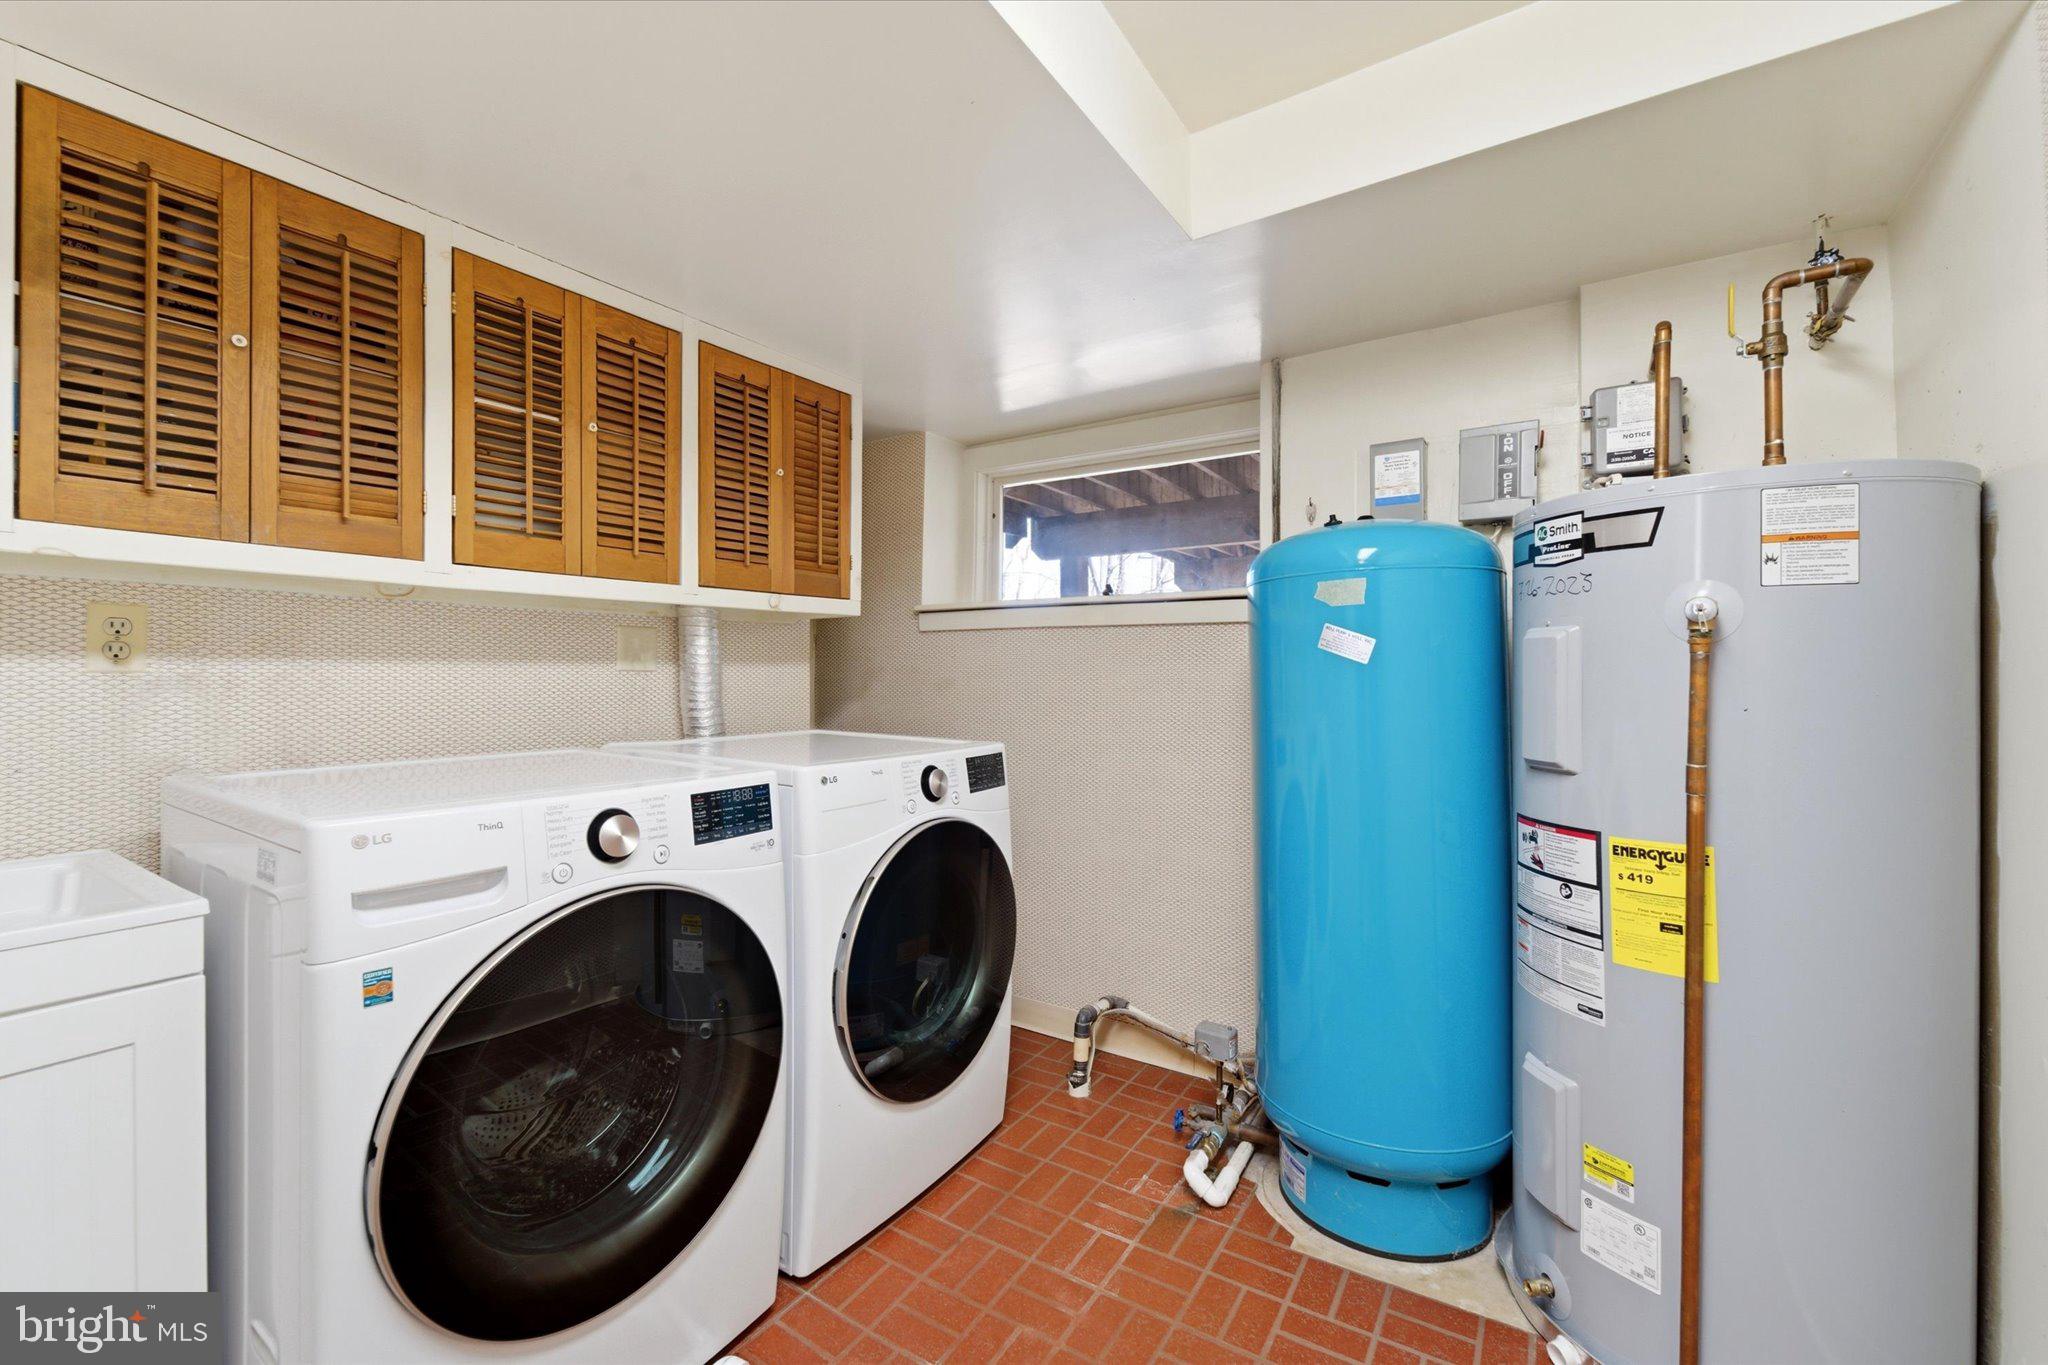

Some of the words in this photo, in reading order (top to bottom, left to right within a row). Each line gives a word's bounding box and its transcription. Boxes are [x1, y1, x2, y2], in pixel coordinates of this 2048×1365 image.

[1622, 431, 1651, 439] NOTICE
[1549, 523, 1579, 537] Smith
[829, 775, 838, 784] LG
[477, 821, 504, 832] ThinQ
[372, 833, 393, 846] LG
[1612, 844, 1710, 870] ENERGYGUE
[1618, 872, 1624, 880] $
[1627, 872, 1654, 885] 419
